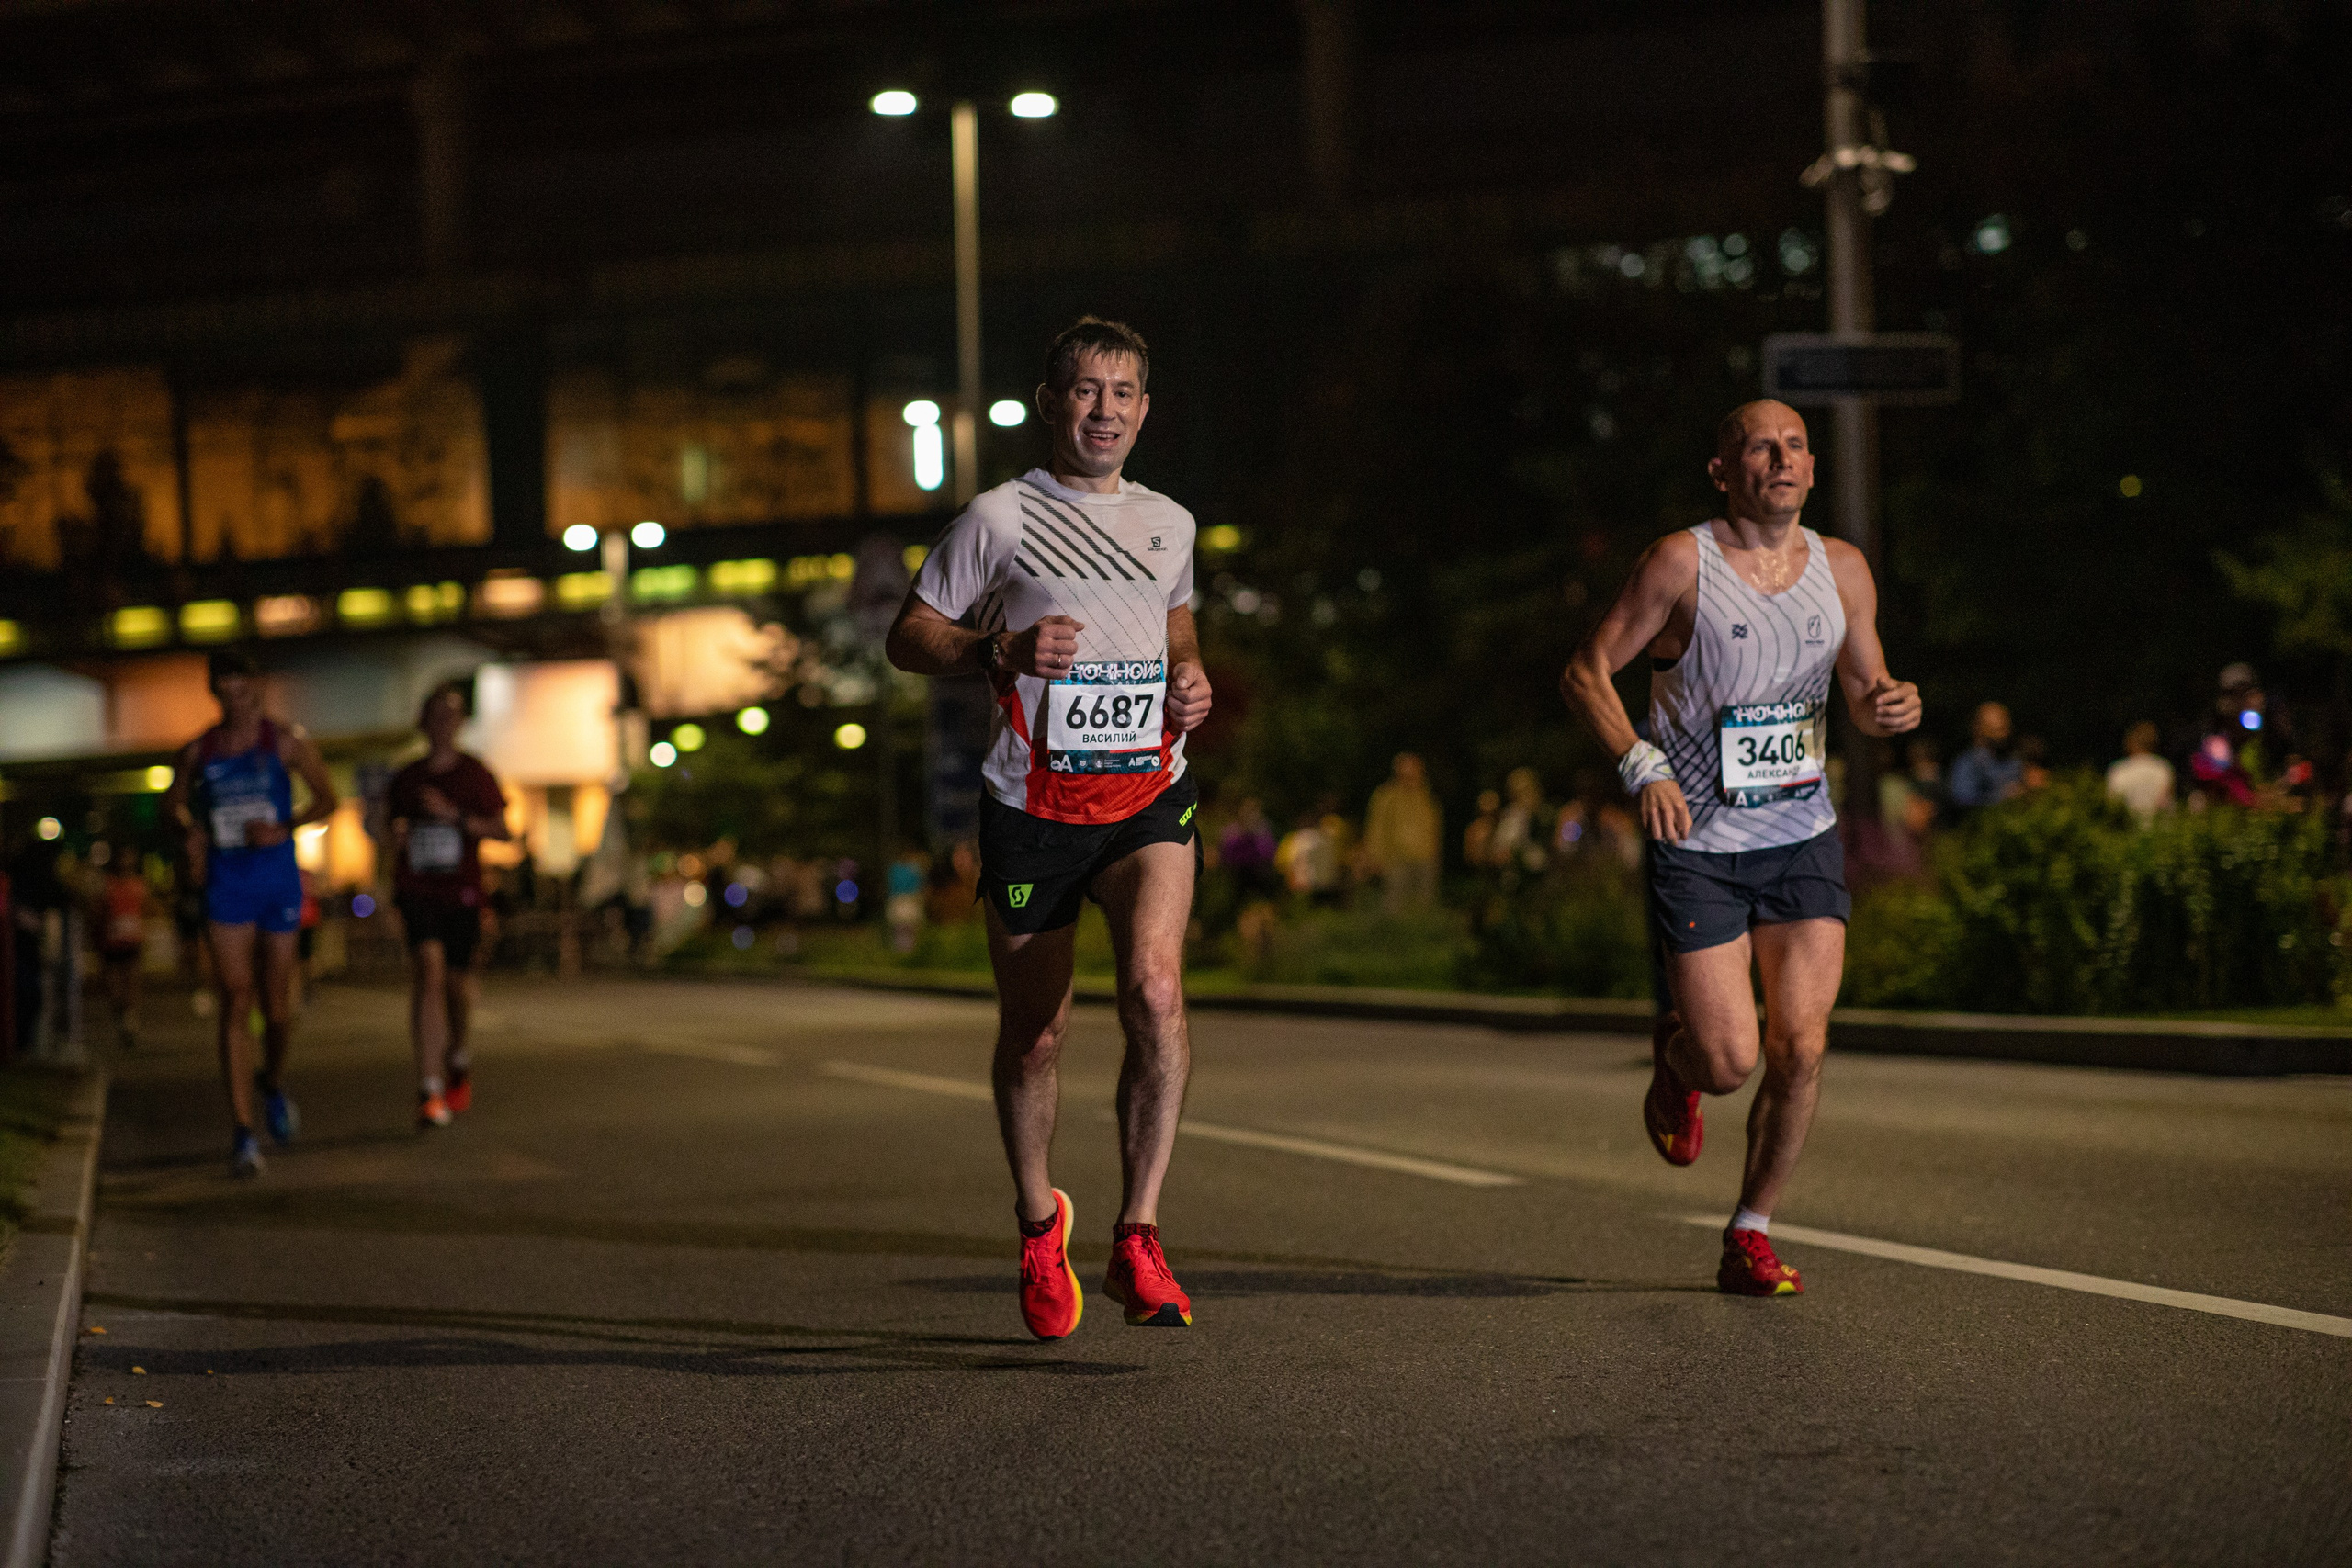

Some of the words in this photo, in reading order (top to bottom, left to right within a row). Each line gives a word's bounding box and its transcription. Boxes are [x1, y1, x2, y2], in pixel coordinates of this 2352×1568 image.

[1066, 694, 1154, 729] 6687
[1082, 731, 1136, 743] ВАСИЛИЙ
[1737, 731, 1805, 766] 3406
